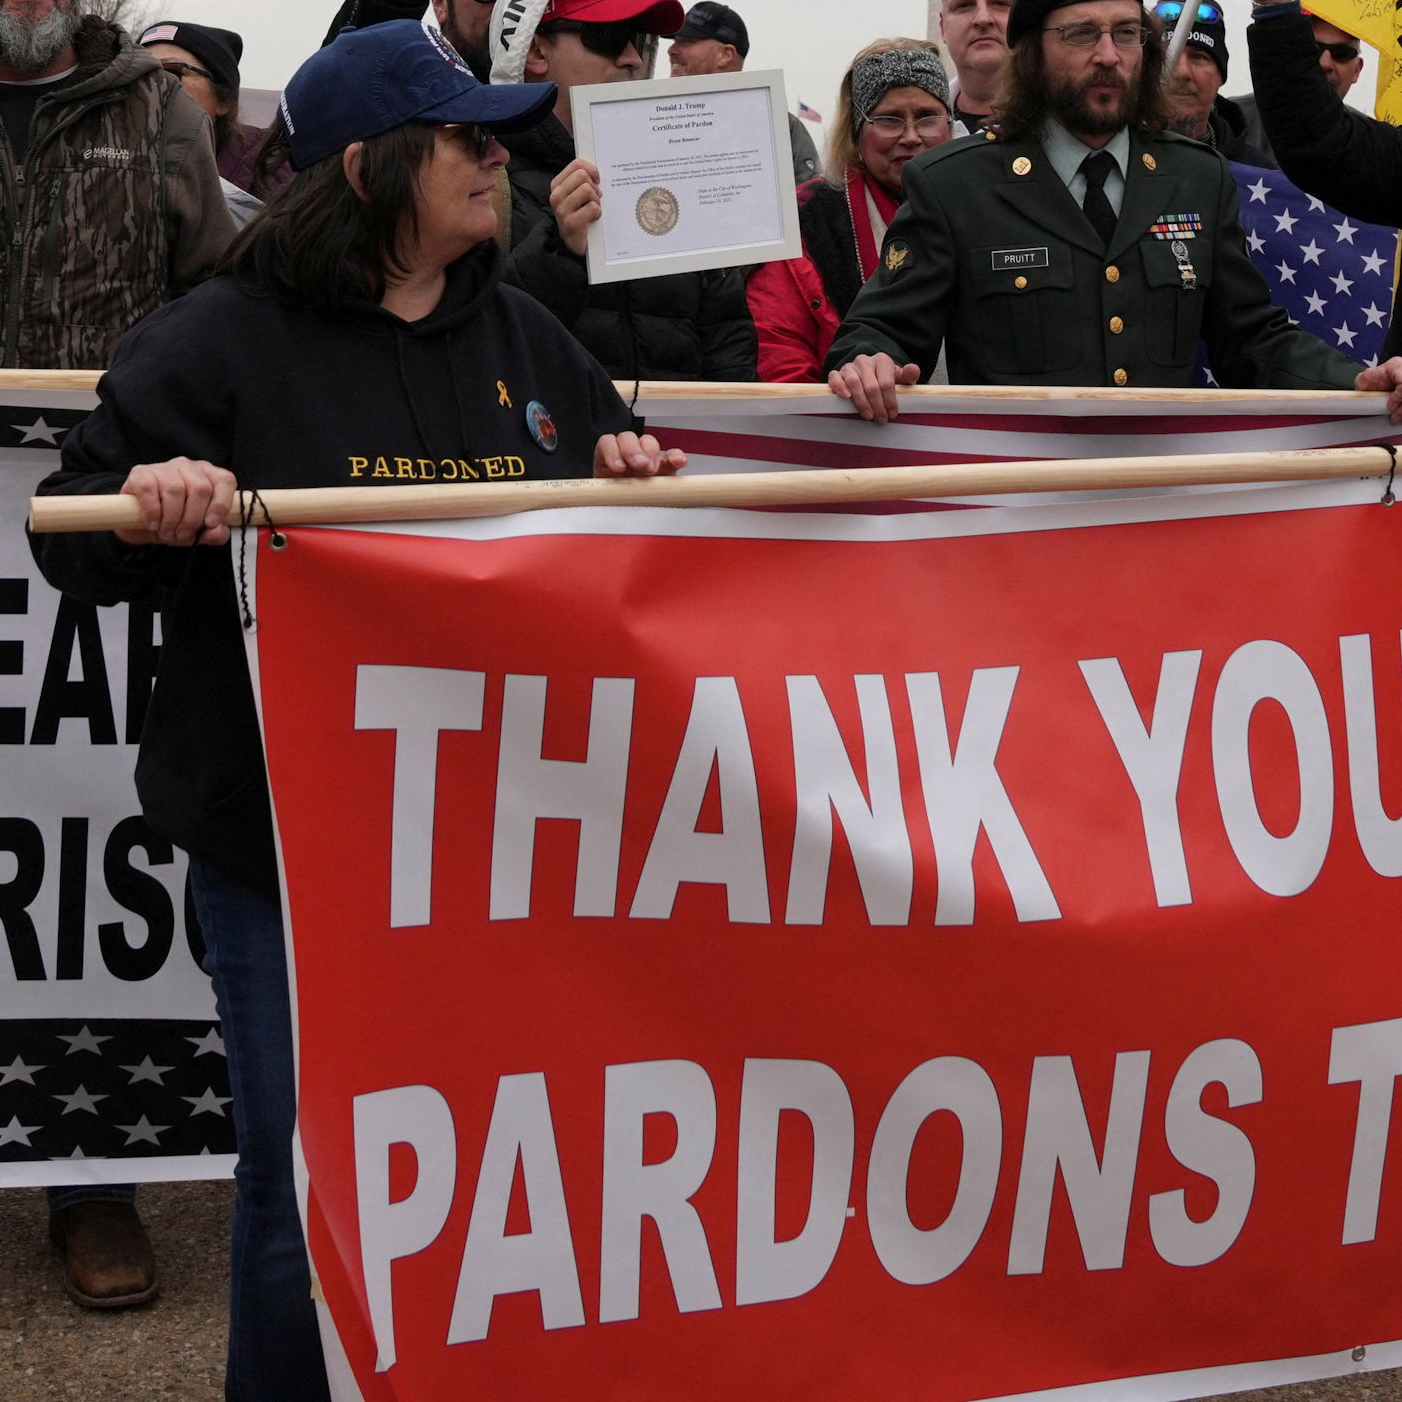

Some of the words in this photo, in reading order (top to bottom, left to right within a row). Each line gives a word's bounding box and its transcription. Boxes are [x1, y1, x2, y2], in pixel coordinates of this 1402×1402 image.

[656, 104, 677, 112] Donald
[685, 102, 706, 110] Trump
[652, 124, 683, 132] Certificate
[691, 120, 713, 128] Pardon
[93, 147, 129, 156] MAGELLAN
[1004, 253, 1035, 264] PRUITT
[348, 455, 526, 480] PARDONED
[353, 663, 1064, 929] THANK
[352, 1036, 1264, 1374] PARDONS
